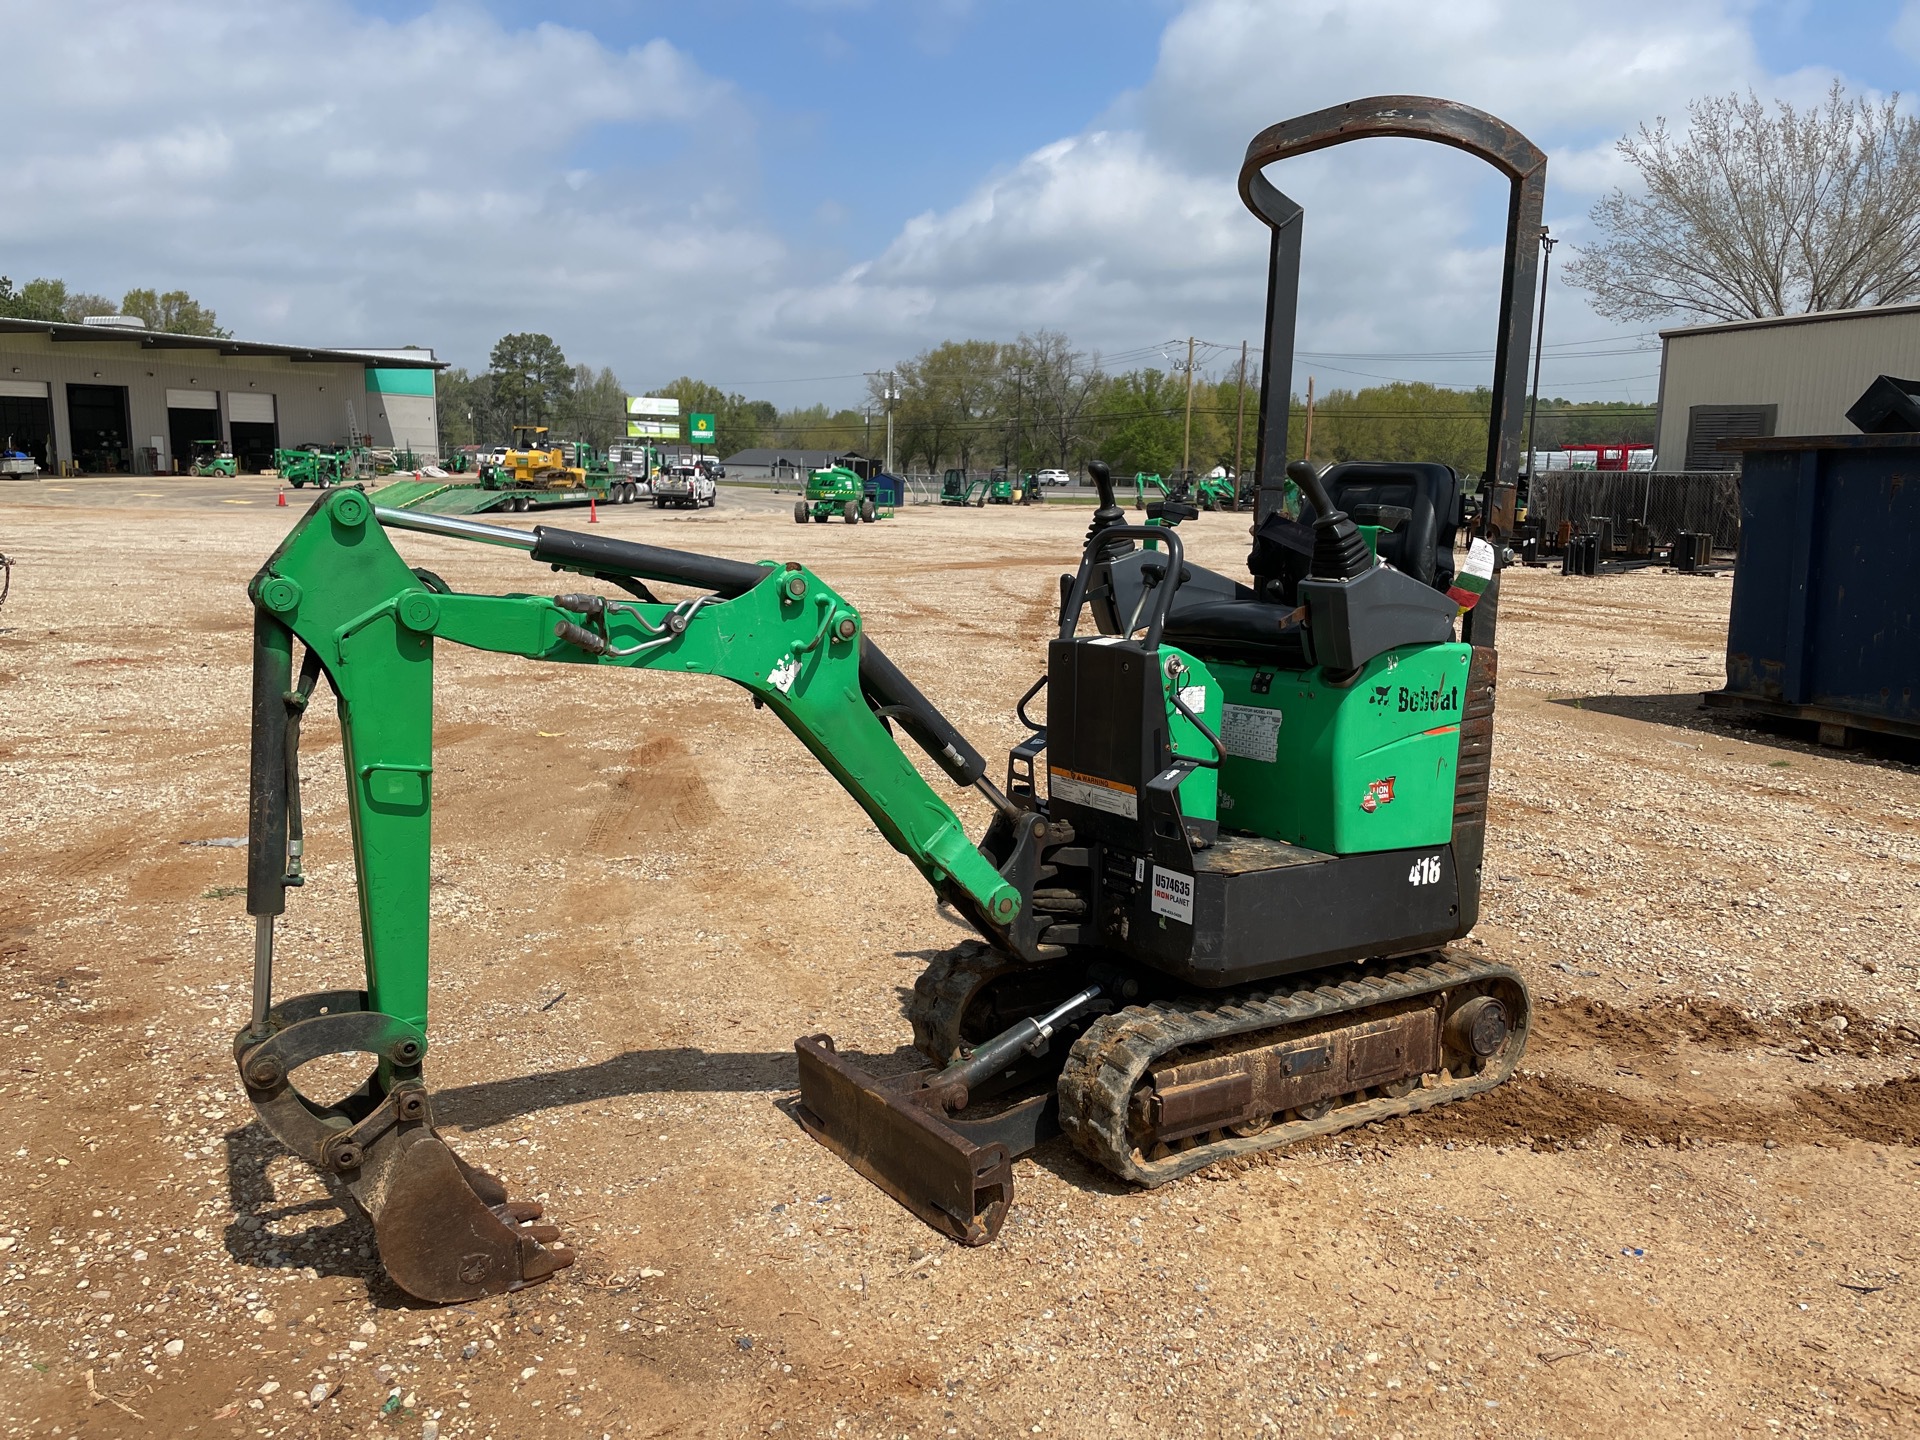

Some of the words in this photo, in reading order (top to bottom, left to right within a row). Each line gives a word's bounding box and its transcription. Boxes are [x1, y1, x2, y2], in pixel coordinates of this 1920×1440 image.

[1398, 686, 1457, 712] Bobcat
[1082, 775, 1109, 787] WARNING
[1408, 855, 1441, 886] 418
[1155, 873, 1190, 897] U574635
